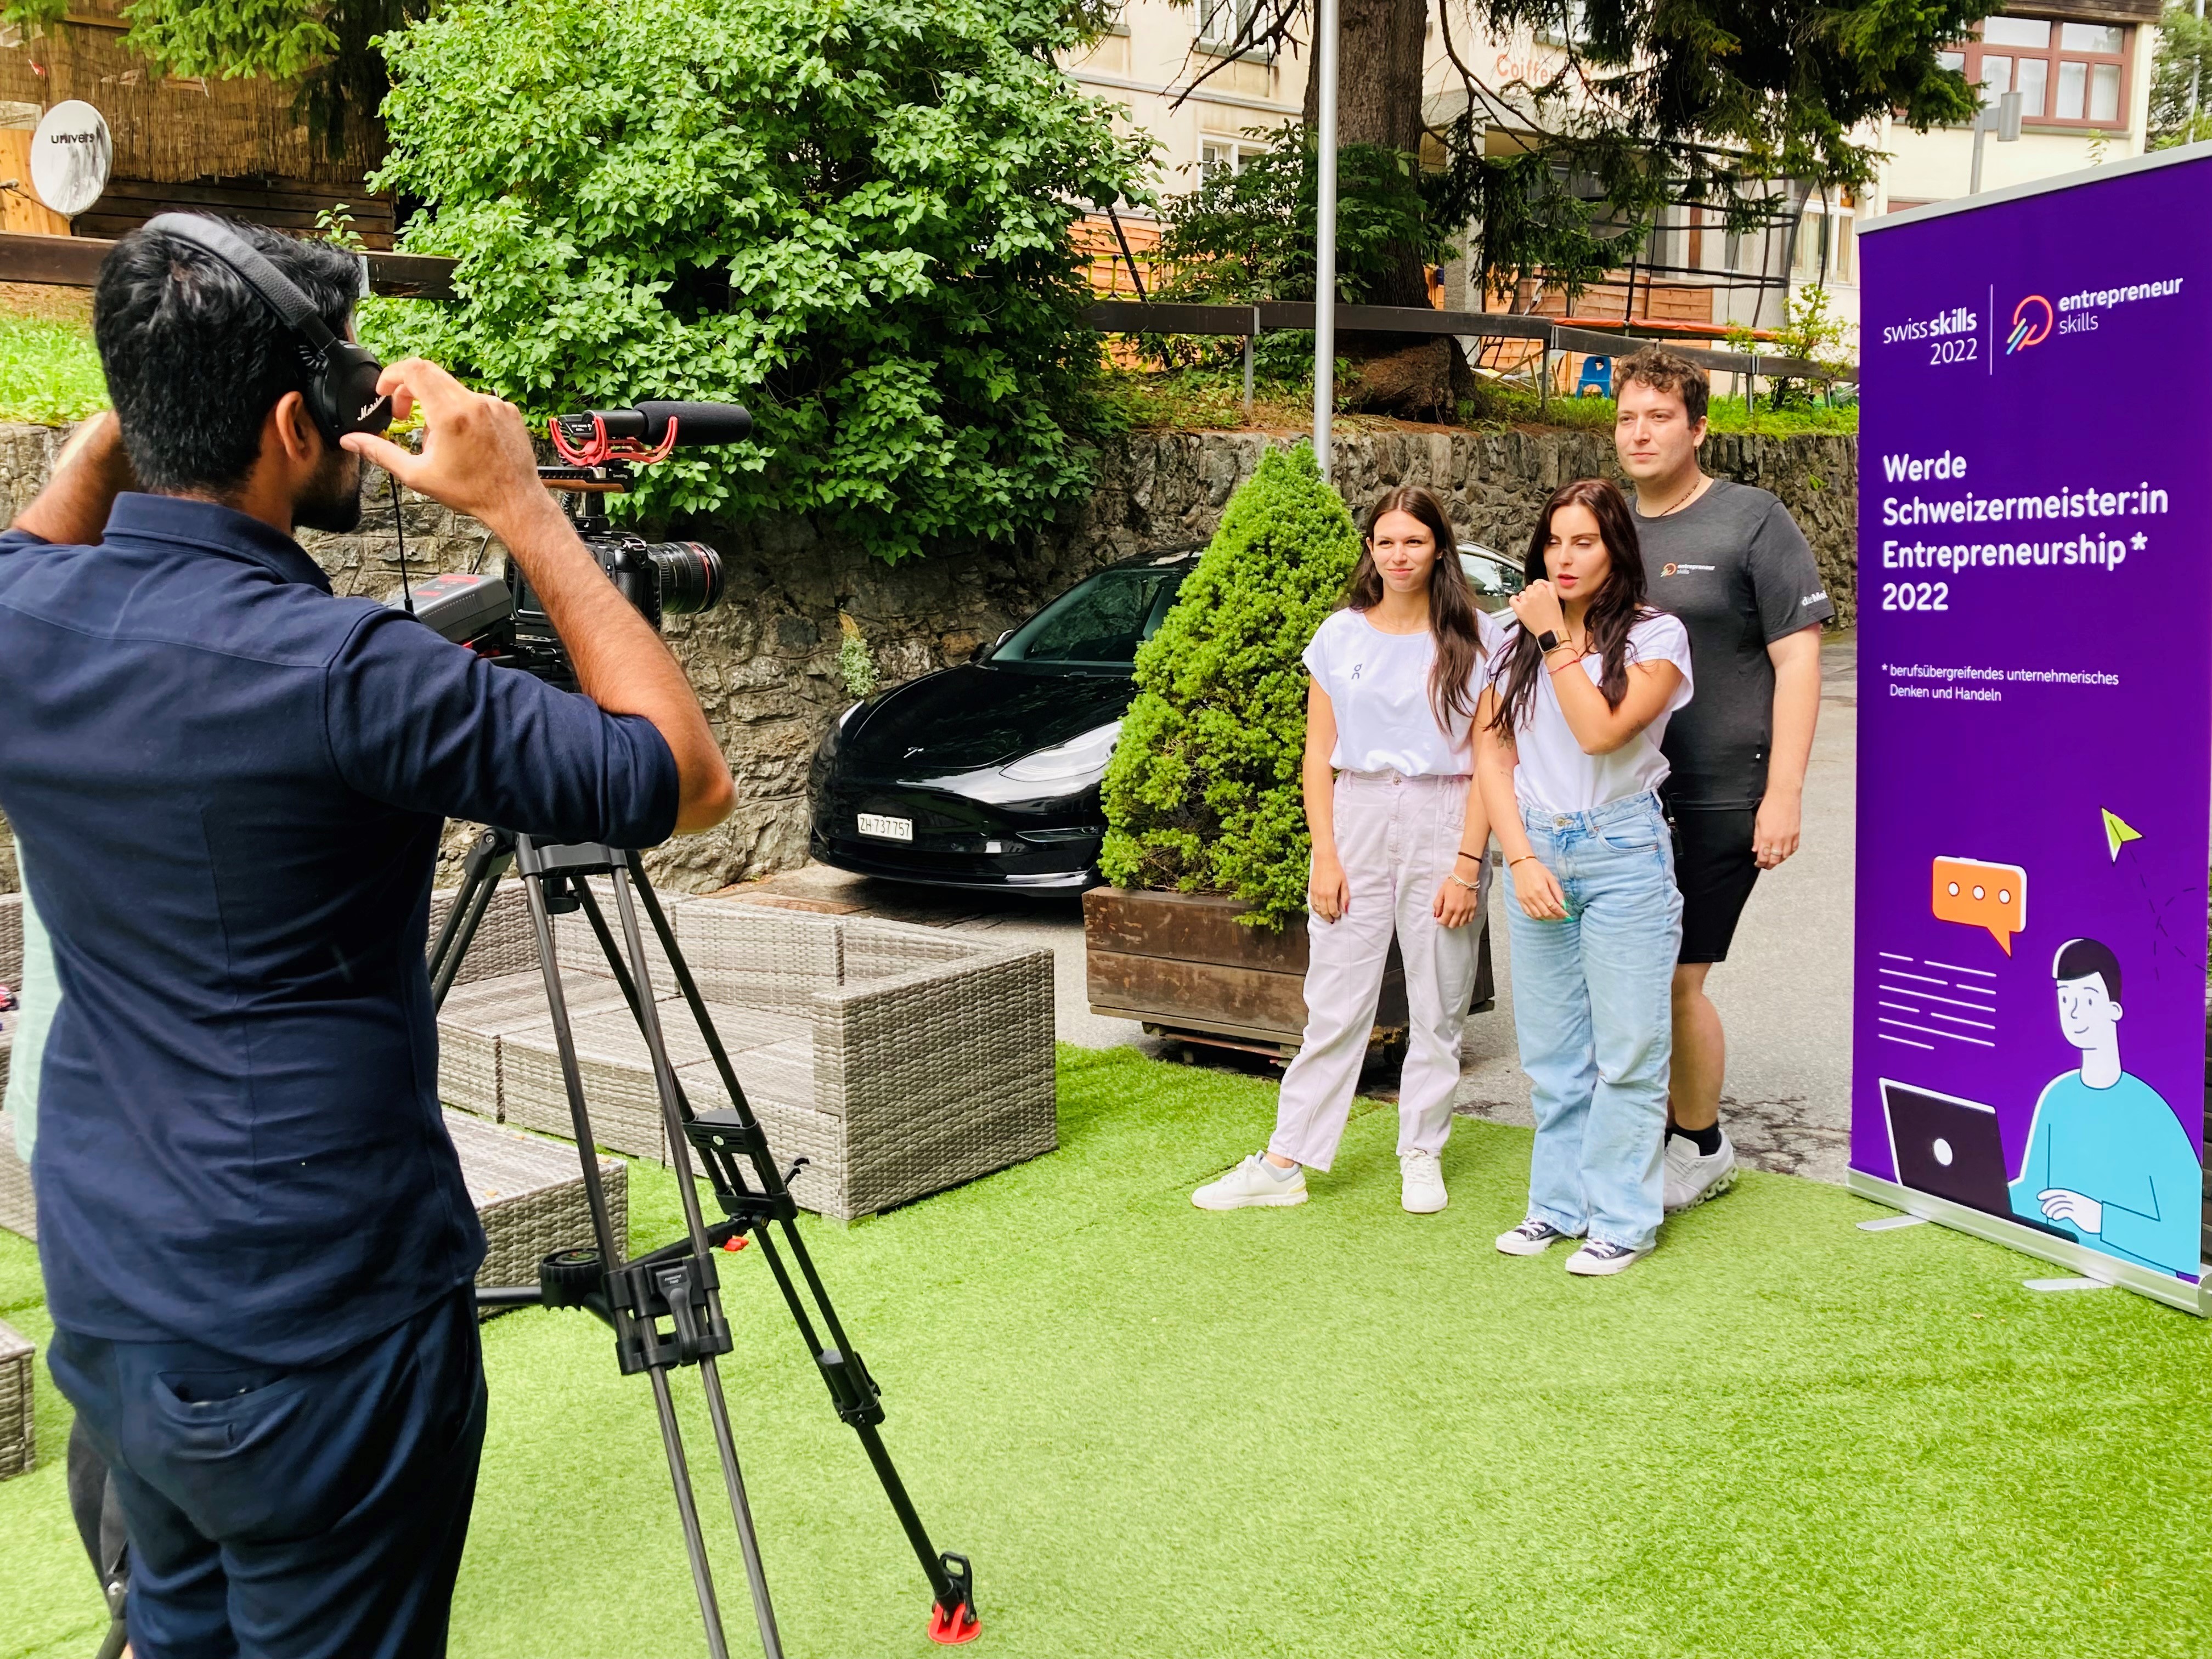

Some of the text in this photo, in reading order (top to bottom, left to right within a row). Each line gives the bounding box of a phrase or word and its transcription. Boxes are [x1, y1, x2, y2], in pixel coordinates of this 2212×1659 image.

[2058, 277, 2183, 311] entrepreneur
[2058, 311, 2099, 335] skills
[1929, 337, 1978, 365] 2022
[1882, 449, 1967, 483] Werde
[1882, 481, 2169, 526] Schweizermeister:in
[1882, 582, 1949, 611] 2022
[1890, 663, 2005, 681] berufsübergreifendes
[2006, 668, 2120, 686] unternehmerisches
[1890, 684, 2002, 702] Denken und Handeln
